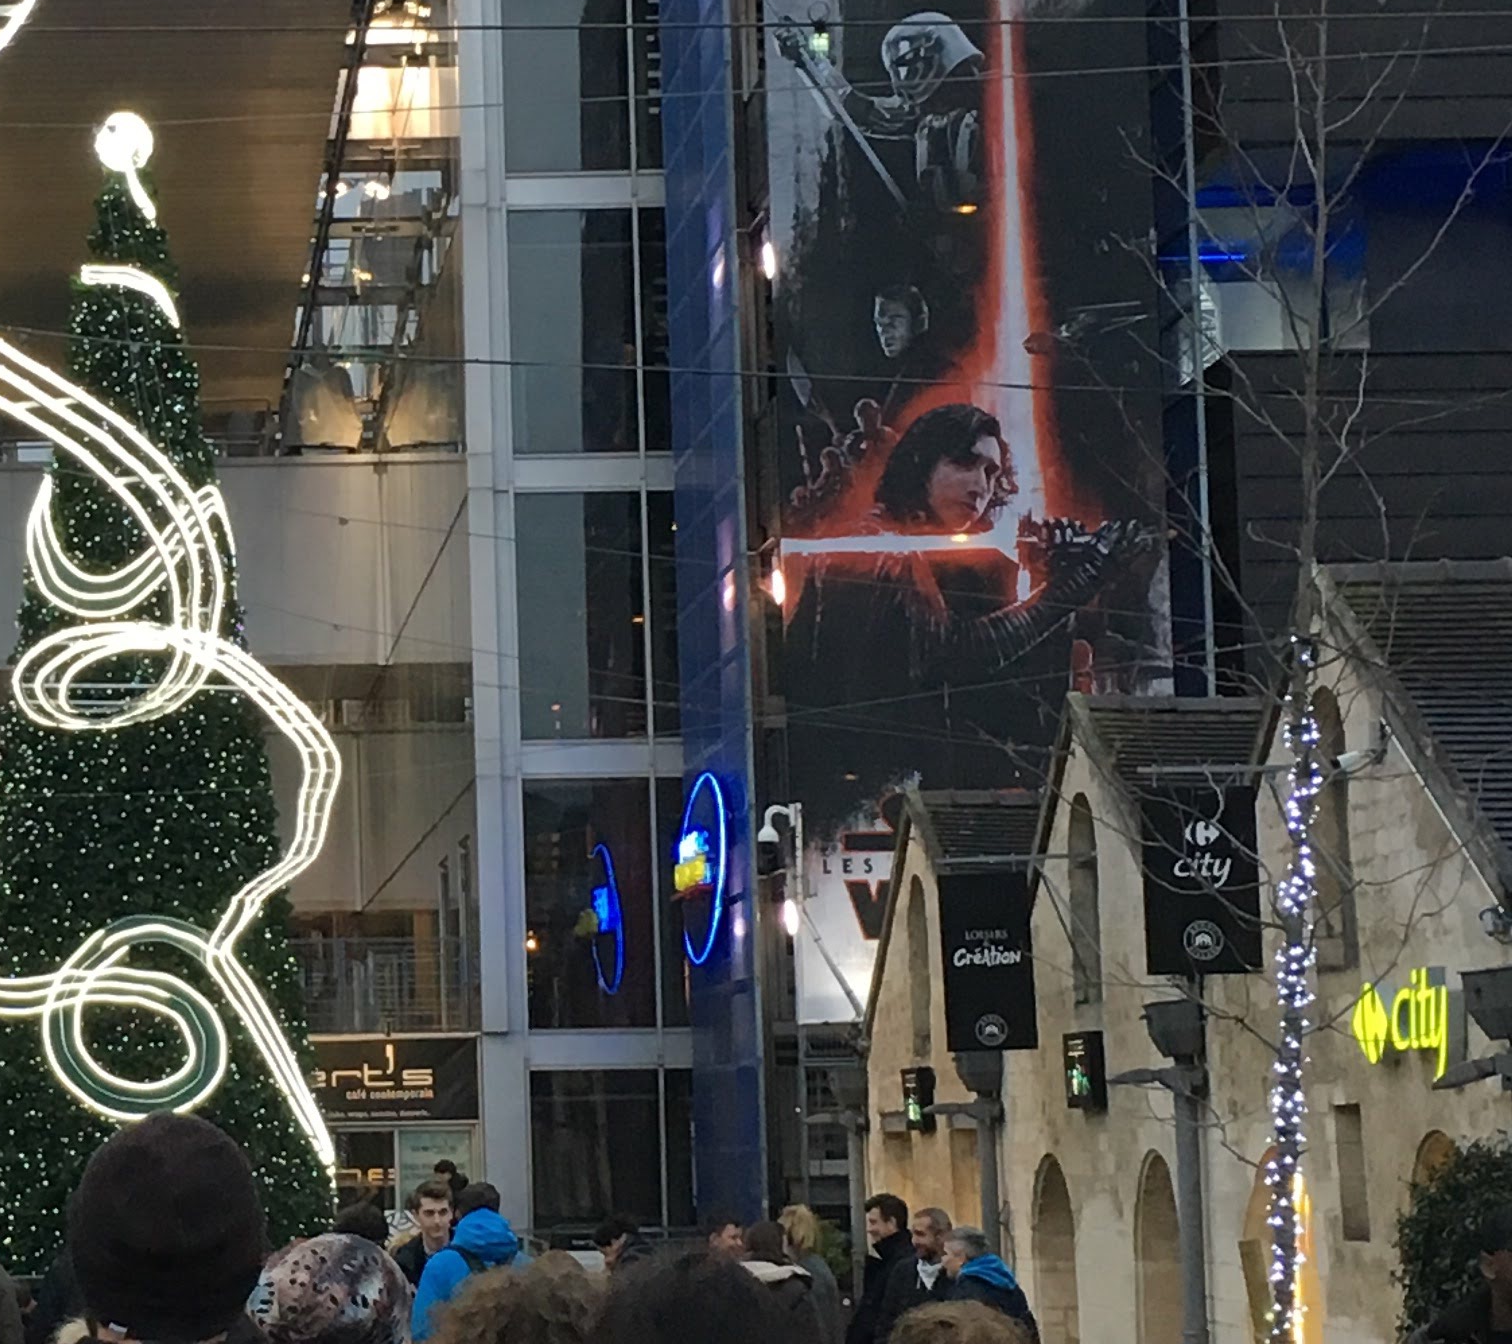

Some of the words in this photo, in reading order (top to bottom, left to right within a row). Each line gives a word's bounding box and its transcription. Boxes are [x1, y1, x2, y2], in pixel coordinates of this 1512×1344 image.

[822, 858, 874, 875] LES
[1391, 967, 1447, 1083] city
[310, 1043, 434, 1088] ert's
